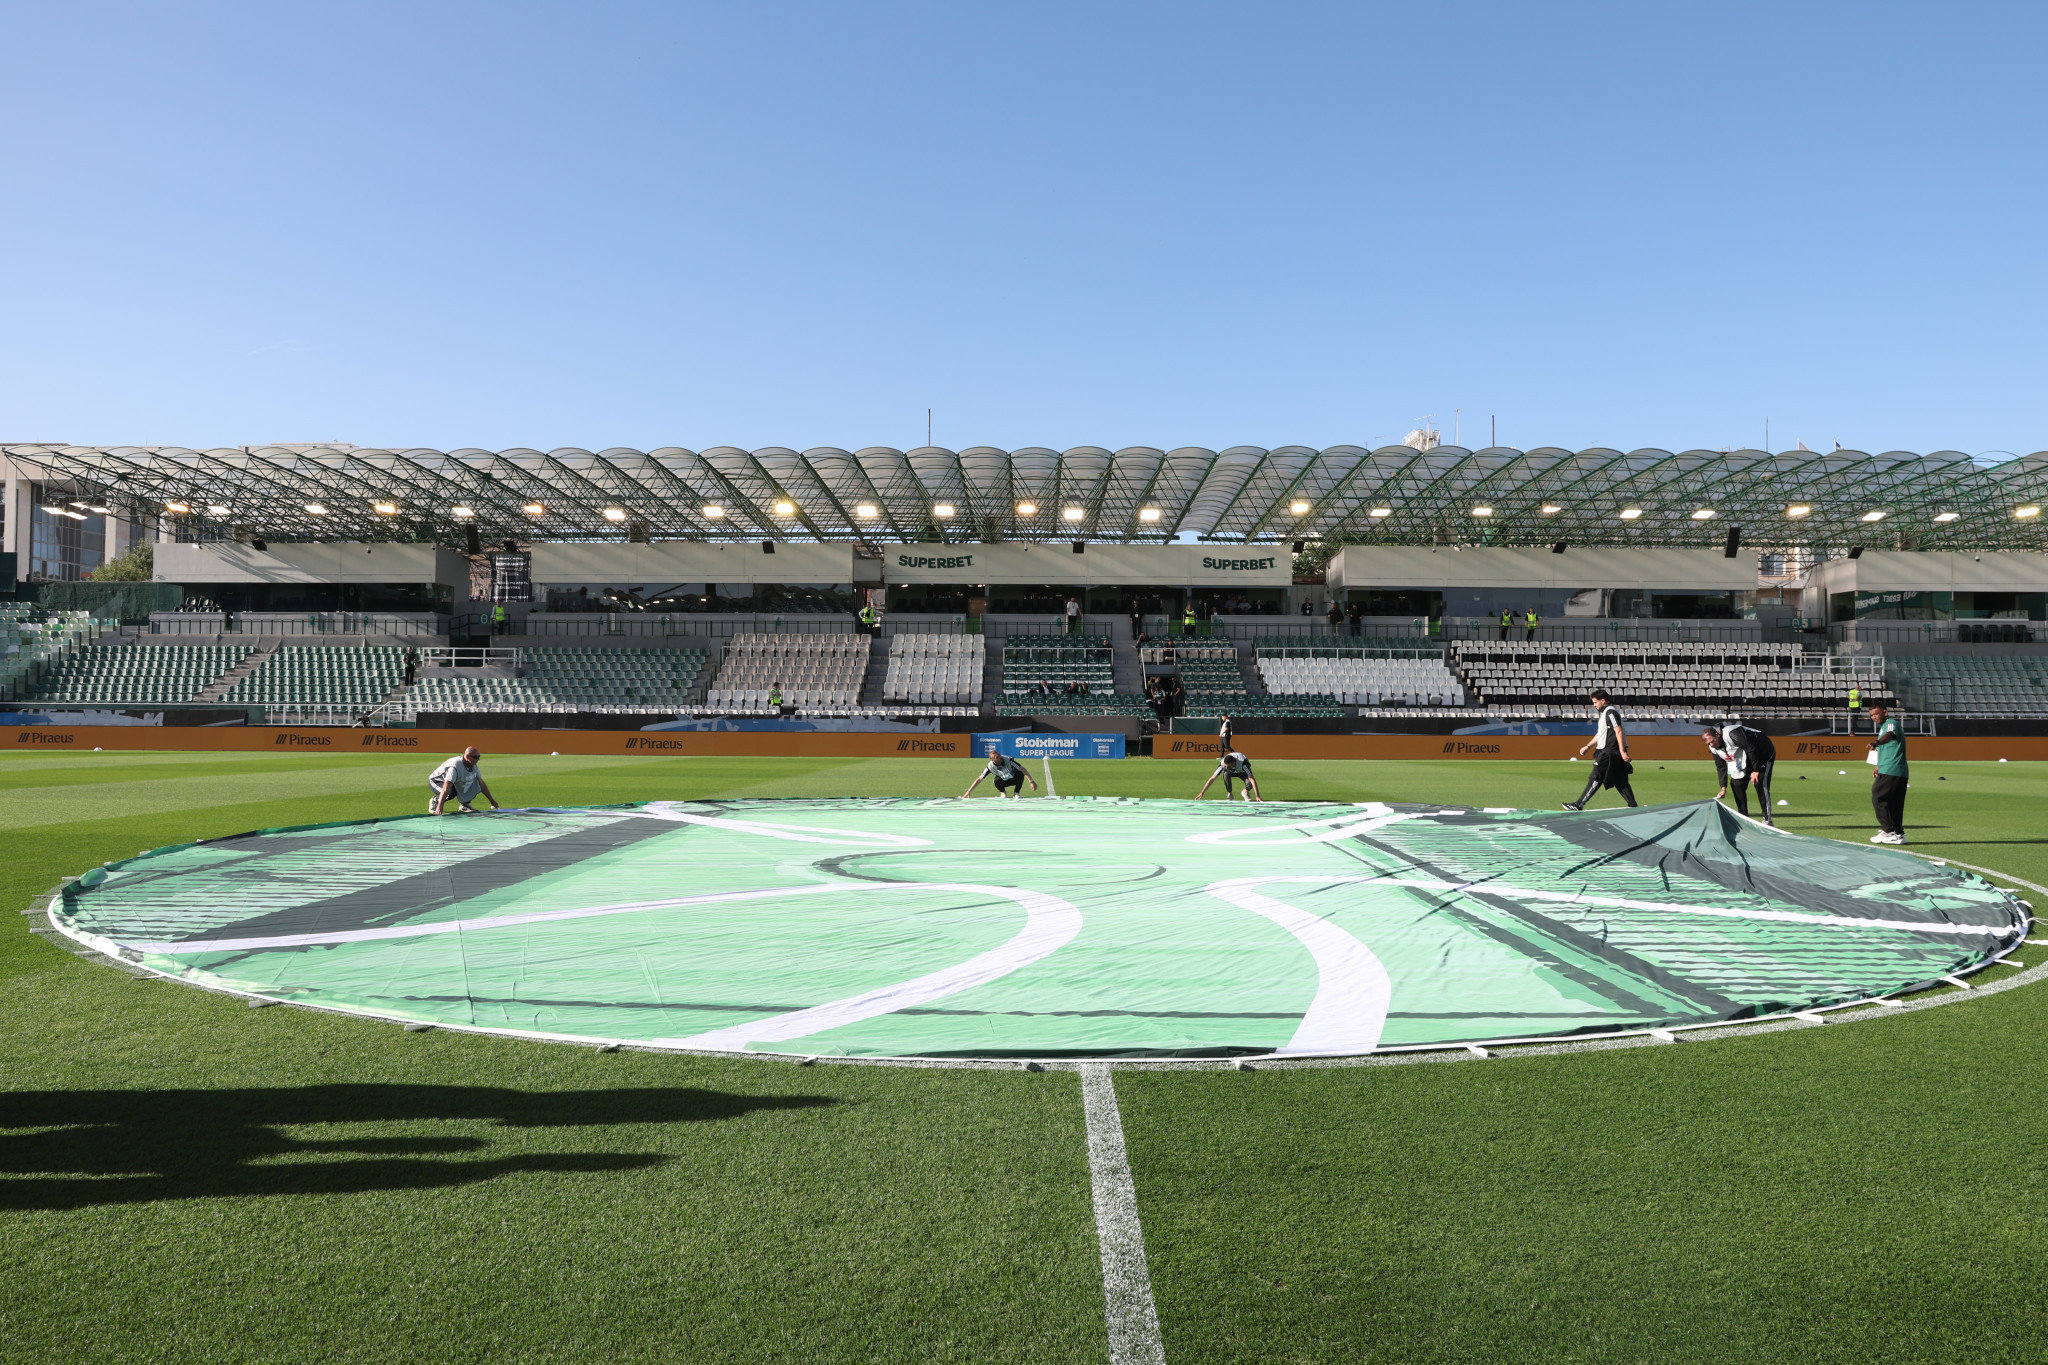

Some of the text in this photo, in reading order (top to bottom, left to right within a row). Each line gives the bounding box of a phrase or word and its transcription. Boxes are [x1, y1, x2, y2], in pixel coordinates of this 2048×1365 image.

[898, 555, 973, 569] SUPERBET
[1202, 557, 1276, 571] SUPERBET
[956, 617, 961, 627] 7
[1158, 618, 1163, 628] 9
[1213, 619, 1224, 629] 10
[1922, 623, 1932, 634] 15
[32, 732, 74, 743] Piraeus
[289, 734, 331, 745] Piraeus
[376, 735, 418, 746] Piraeus
[1016, 737, 1079, 748] Stoiximan
[640, 738, 683, 750] Piraeus
[912, 740, 956, 752] Piraeus
[1457, 742, 1500, 753] Piraeus
[1810, 743, 1851, 754] Piraeus
